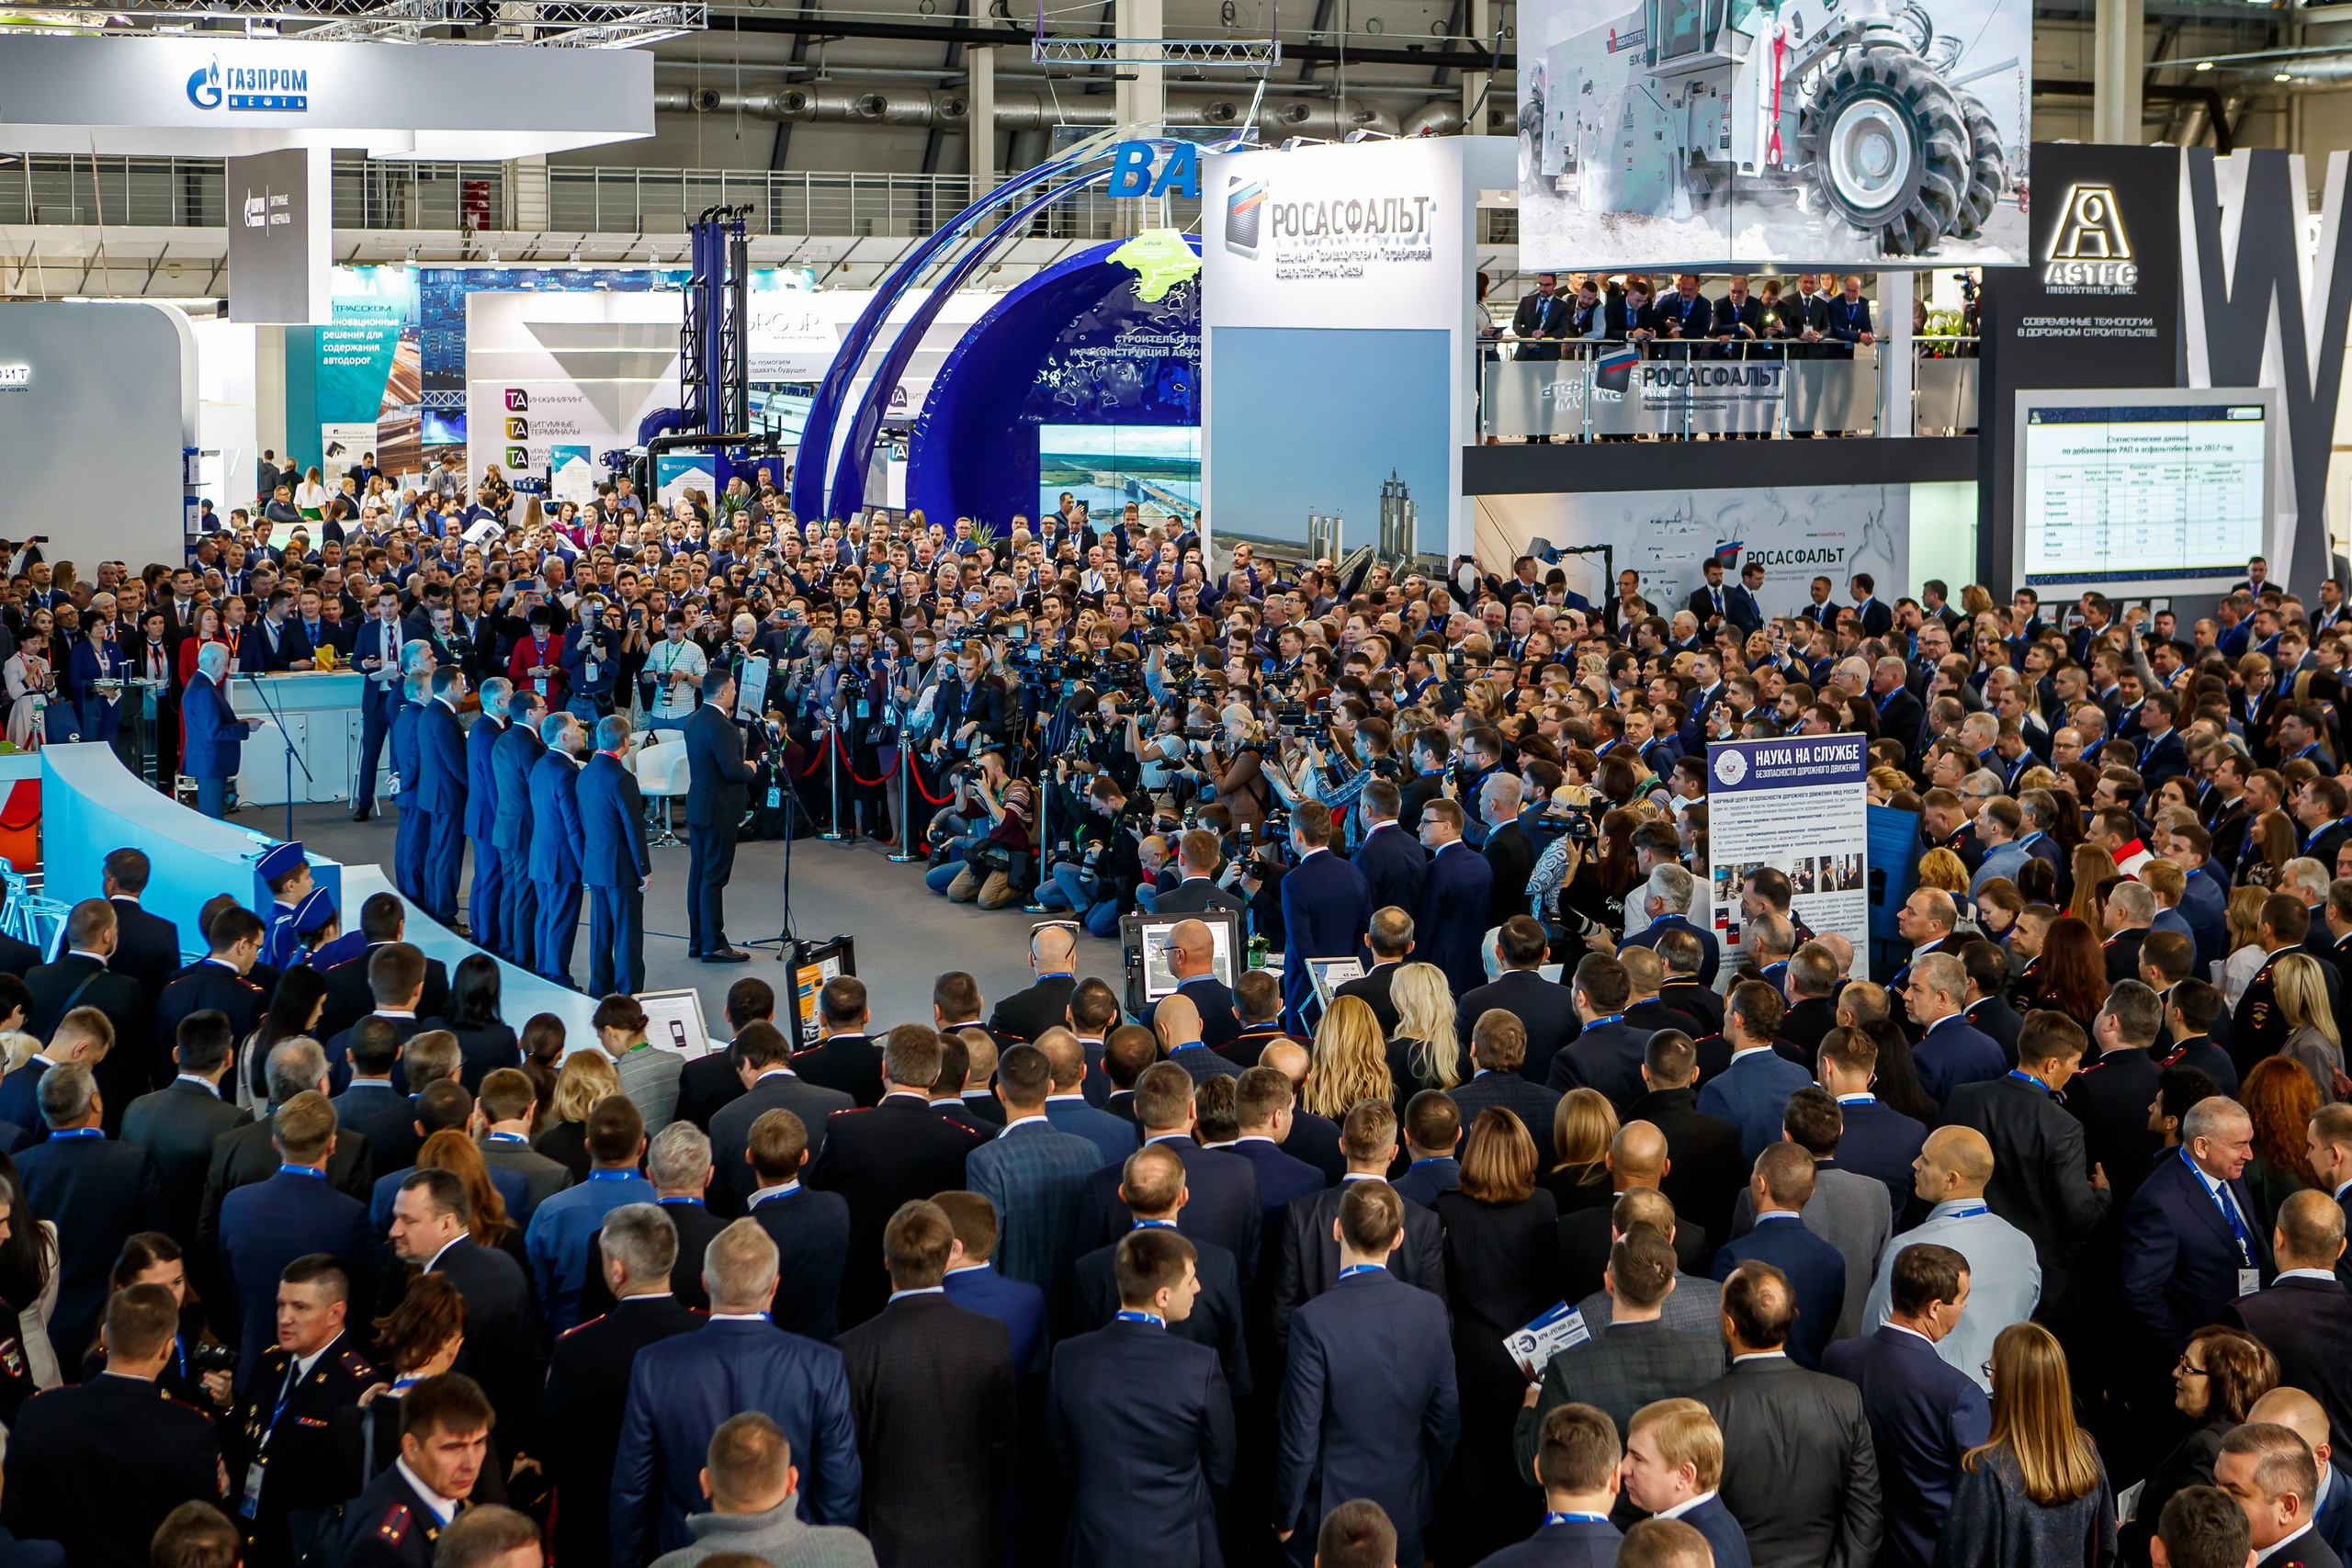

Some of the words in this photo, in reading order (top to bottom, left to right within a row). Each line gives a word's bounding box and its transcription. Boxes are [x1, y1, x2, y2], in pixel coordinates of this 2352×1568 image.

[228, 68, 308, 91] ГАЗПРОМ
[231, 96, 304, 107] НЕФТЬ
[1107, 142, 1202, 198] ВА
[1272, 197, 1430, 238] РОСАСФАЛЬТ
[2045, 263, 2138, 286] ASTEC
[332, 319, 399, 327] нновационные
[2022, 317, 2092, 326] СОВРЕМЕННЫЕ
[2094, 317, 2154, 326] ТЕХНОЛОГИИ
[323, 332, 365, 341] решения
[366, 331, 383, 340] для
[2018, 329, 2025, 337] В
[2026, 328, 2081, 337] ДОРОЖНОМ
[2083, 328, 2158, 337] СТРОИТЕЛЬСТВЕ
[323, 344, 380, 353] содержания
[323, 356, 371, 366] автодорог
[777, 366, 807, 374] будущее
[1643, 367, 1783, 387] РОСАСФАЛЬТ
[2107, 435, 2162, 444] Статистические
[2072, 447, 2118, 456] добавлению
[2119, 446, 2133, 454] РАП
[1747, 547, 1845, 566] РОСАСФАЛЬТ
[1756, 750, 1792, 767] НАУКА
[1795, 748, 1811, 764] НА
[1814, 744, 1860, 763] СЛУЖБЕ
[1756, 767, 1797, 779] БЕЗОПАСНОСТИ
[1797, 765, 1829, 777] ДОРОЖНОГО
[1829, 762, 1860, 774] ДВИЖЕНИЯ
[1749, 794, 1782, 802] БЕЗОПАСНОСТИ
